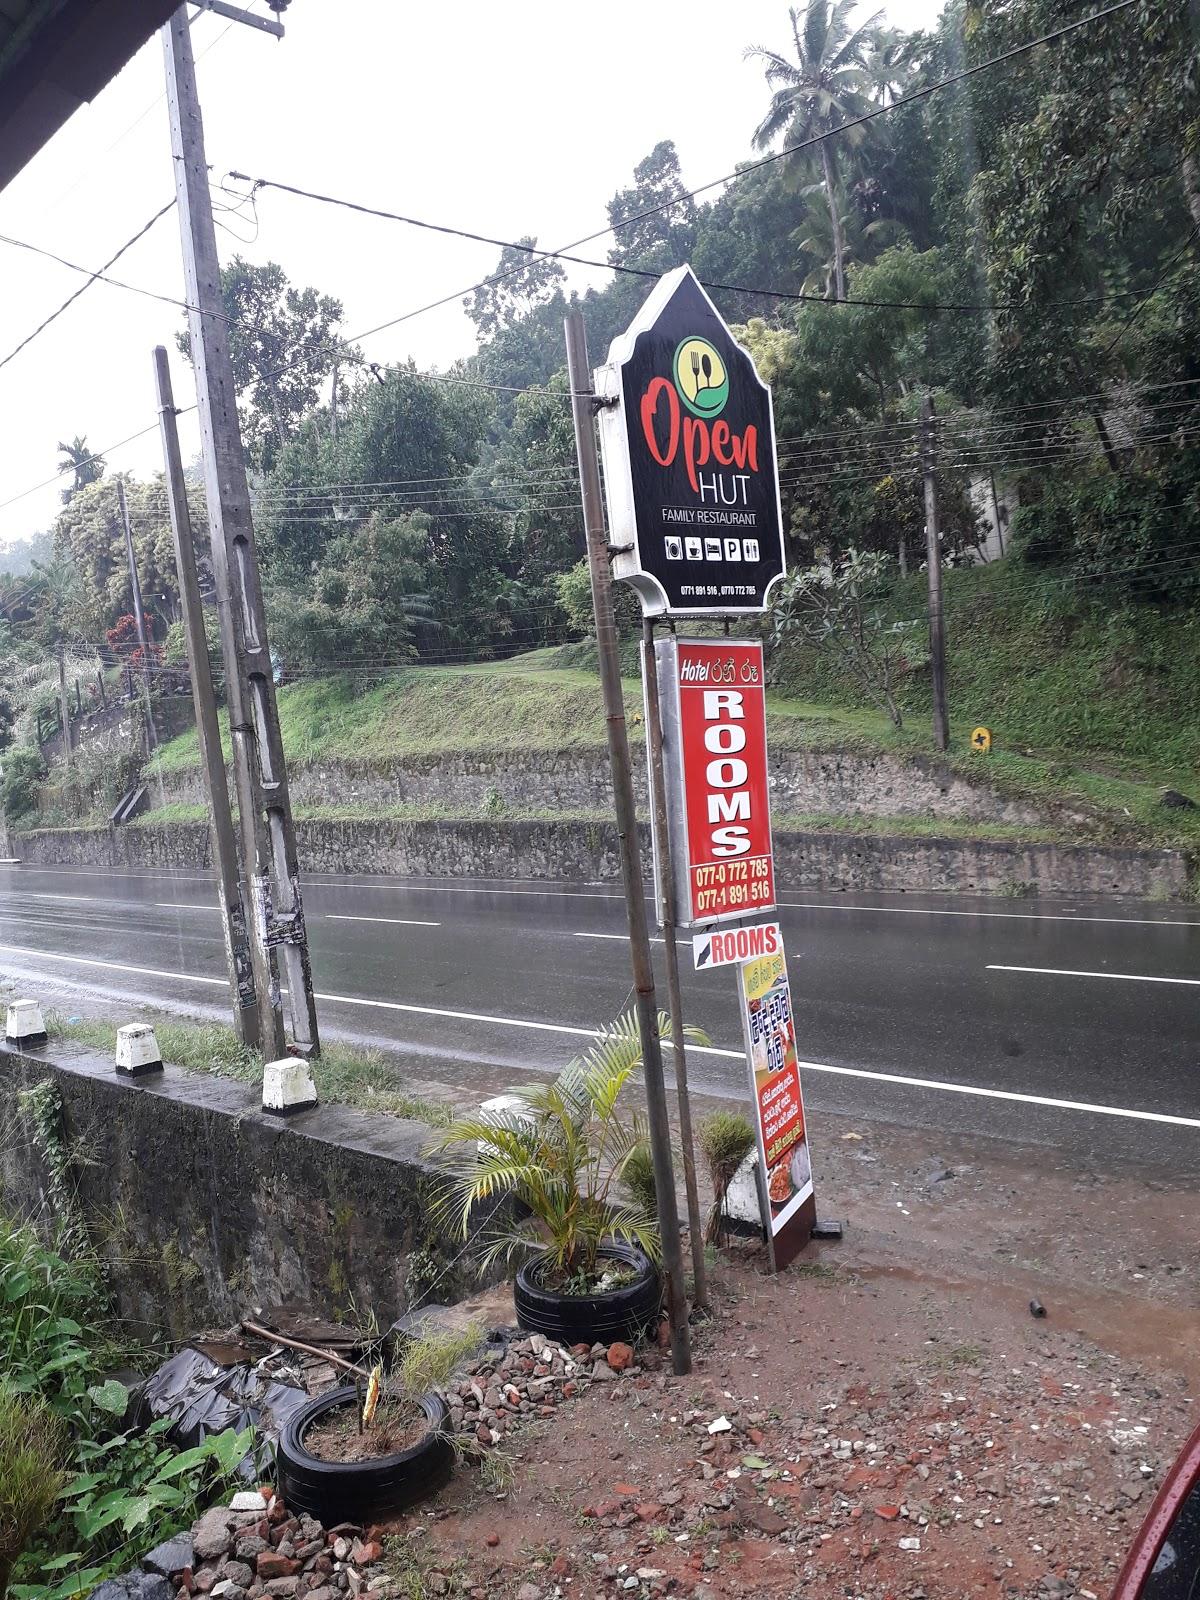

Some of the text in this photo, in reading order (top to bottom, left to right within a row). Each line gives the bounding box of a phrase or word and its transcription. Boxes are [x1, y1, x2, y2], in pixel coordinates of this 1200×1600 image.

[641, 376, 759, 493] Open
[699, 471, 751, 505] HUT
[661, 508, 757, 526] FAMILY RESTAURANT
[680, 585, 695, 596] 0771
[695, 585, 706, 596] 891
[721, 585, 735, 596] 0770
[735, 585, 746, 596] 772
[746, 585, 757, 596] 785
[681, 659, 710, 682] Hotel
[703, 690, 752, 858] ROOMS
[696, 858, 769, 888] 077-0 772 785
[697, 880, 770, 911] 077-1 891 516
[711, 925, 778, 964] ROOMS
